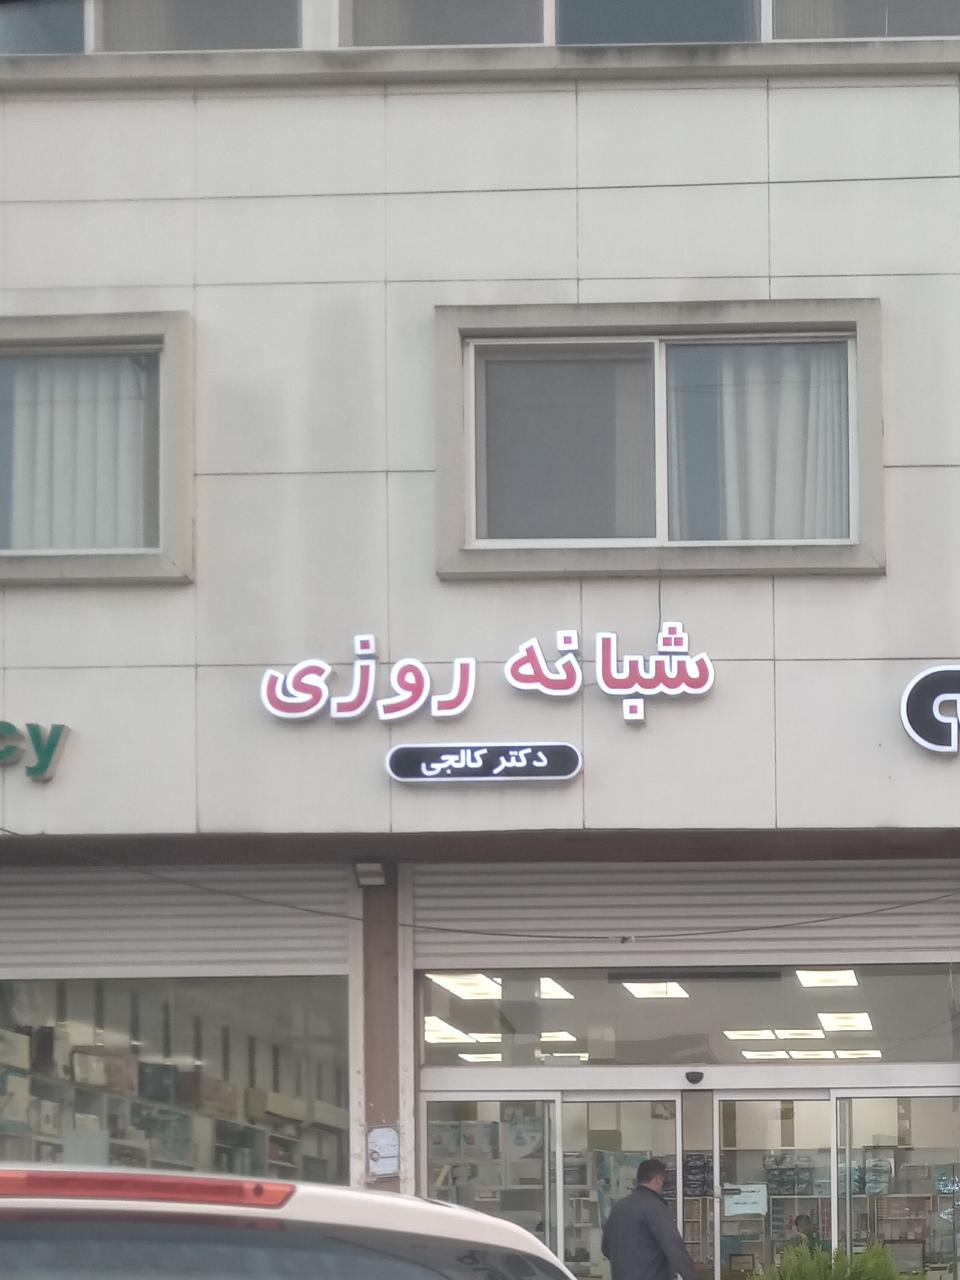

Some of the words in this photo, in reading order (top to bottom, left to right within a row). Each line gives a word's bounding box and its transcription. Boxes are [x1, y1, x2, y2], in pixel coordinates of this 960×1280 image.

[261, 634, 477, 720] روزی
[505, 621, 715, 721] شبانه
[492, 748, 549, 775] دکتر
